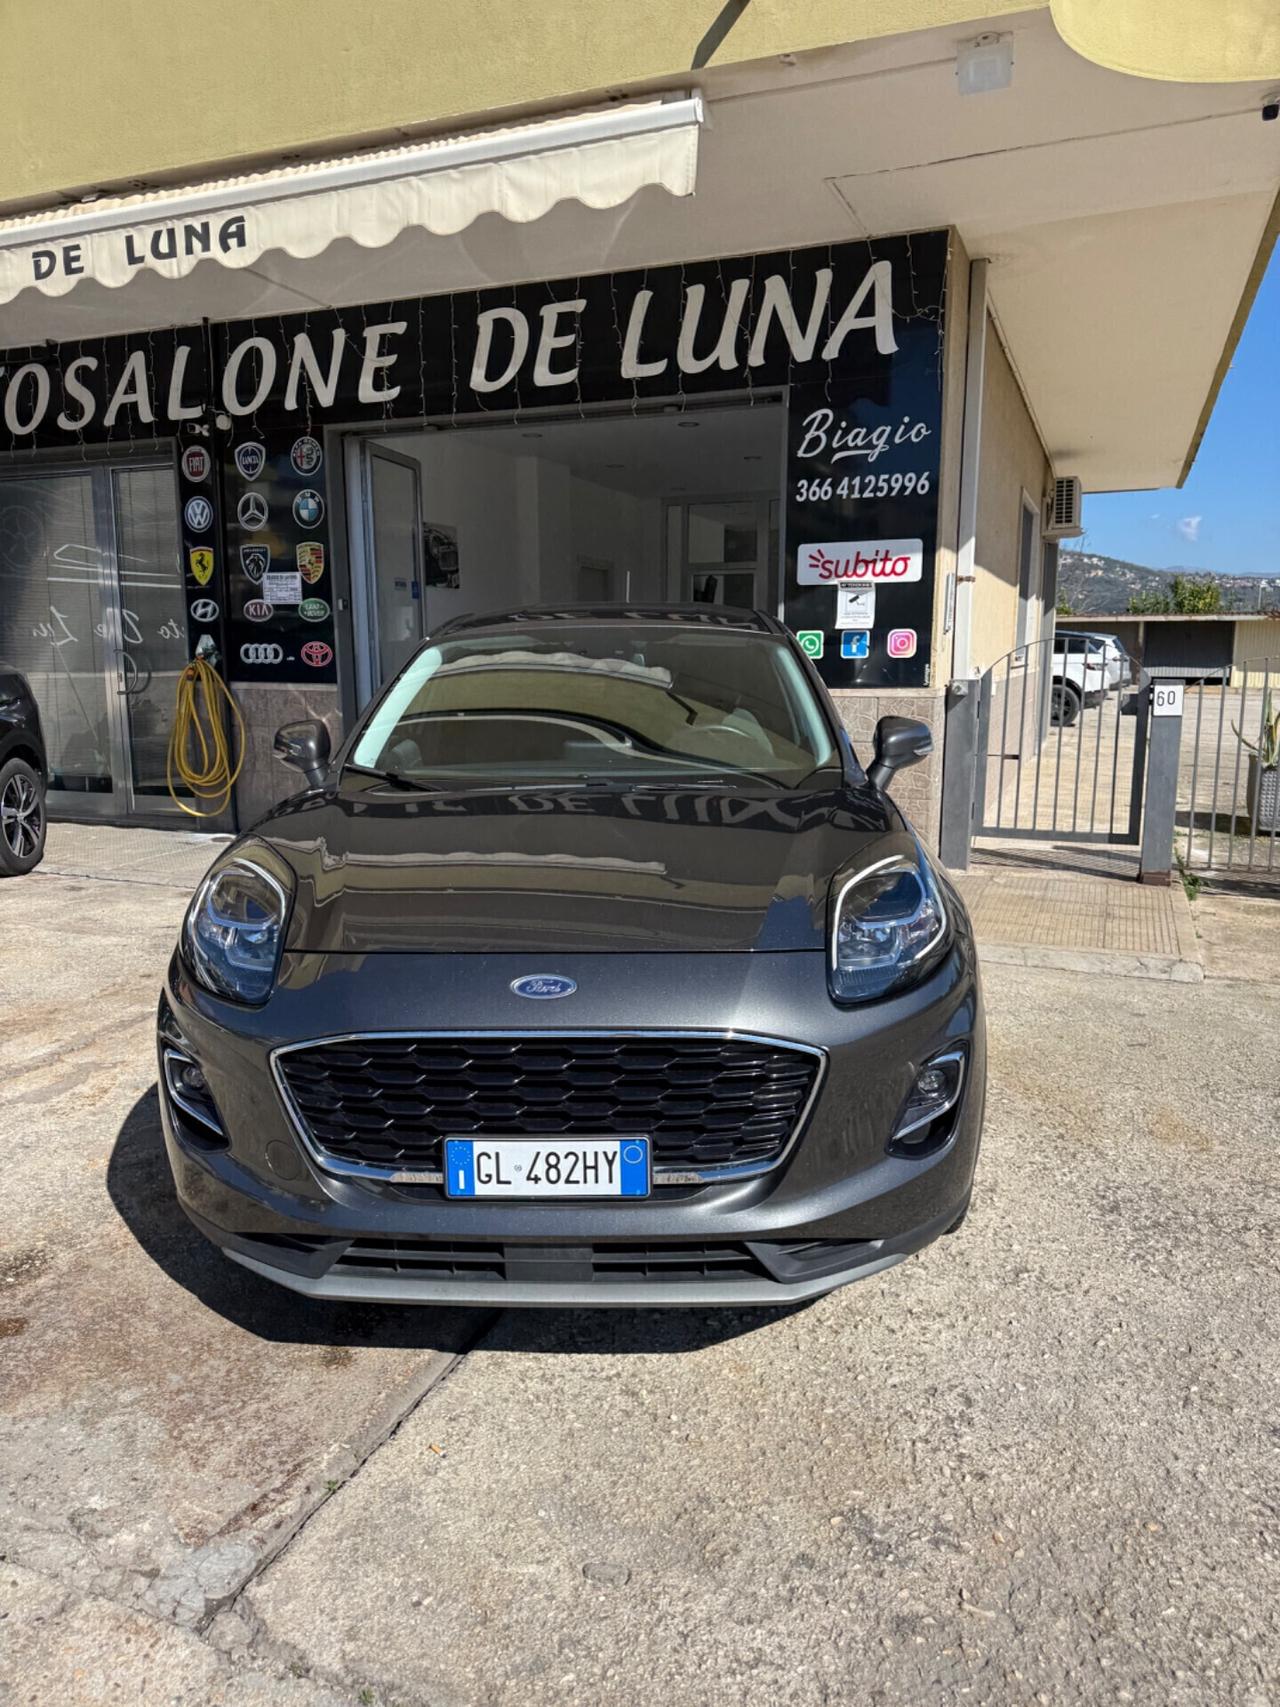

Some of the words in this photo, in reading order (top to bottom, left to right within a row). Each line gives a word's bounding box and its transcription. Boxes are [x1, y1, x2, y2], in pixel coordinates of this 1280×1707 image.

[32, 244, 84, 281] DE
[125, 215, 247, 266] LUNA
[0, 321, 407, 436] OSALONE
[470, 298, 587, 393] DE
[620, 260, 899, 379] LUNA
[797, 408, 931, 464] Biagio
[796, 478, 833, 502] 366
[837, 471, 931, 499] 4125996
[819, 549, 911, 580] subito
[1156, 690, 1176, 707] 60
[525, 979, 562, 993] Ford
[476, 1151, 512, 1185] GL
[526, 1151, 618, 1185] 482HY
